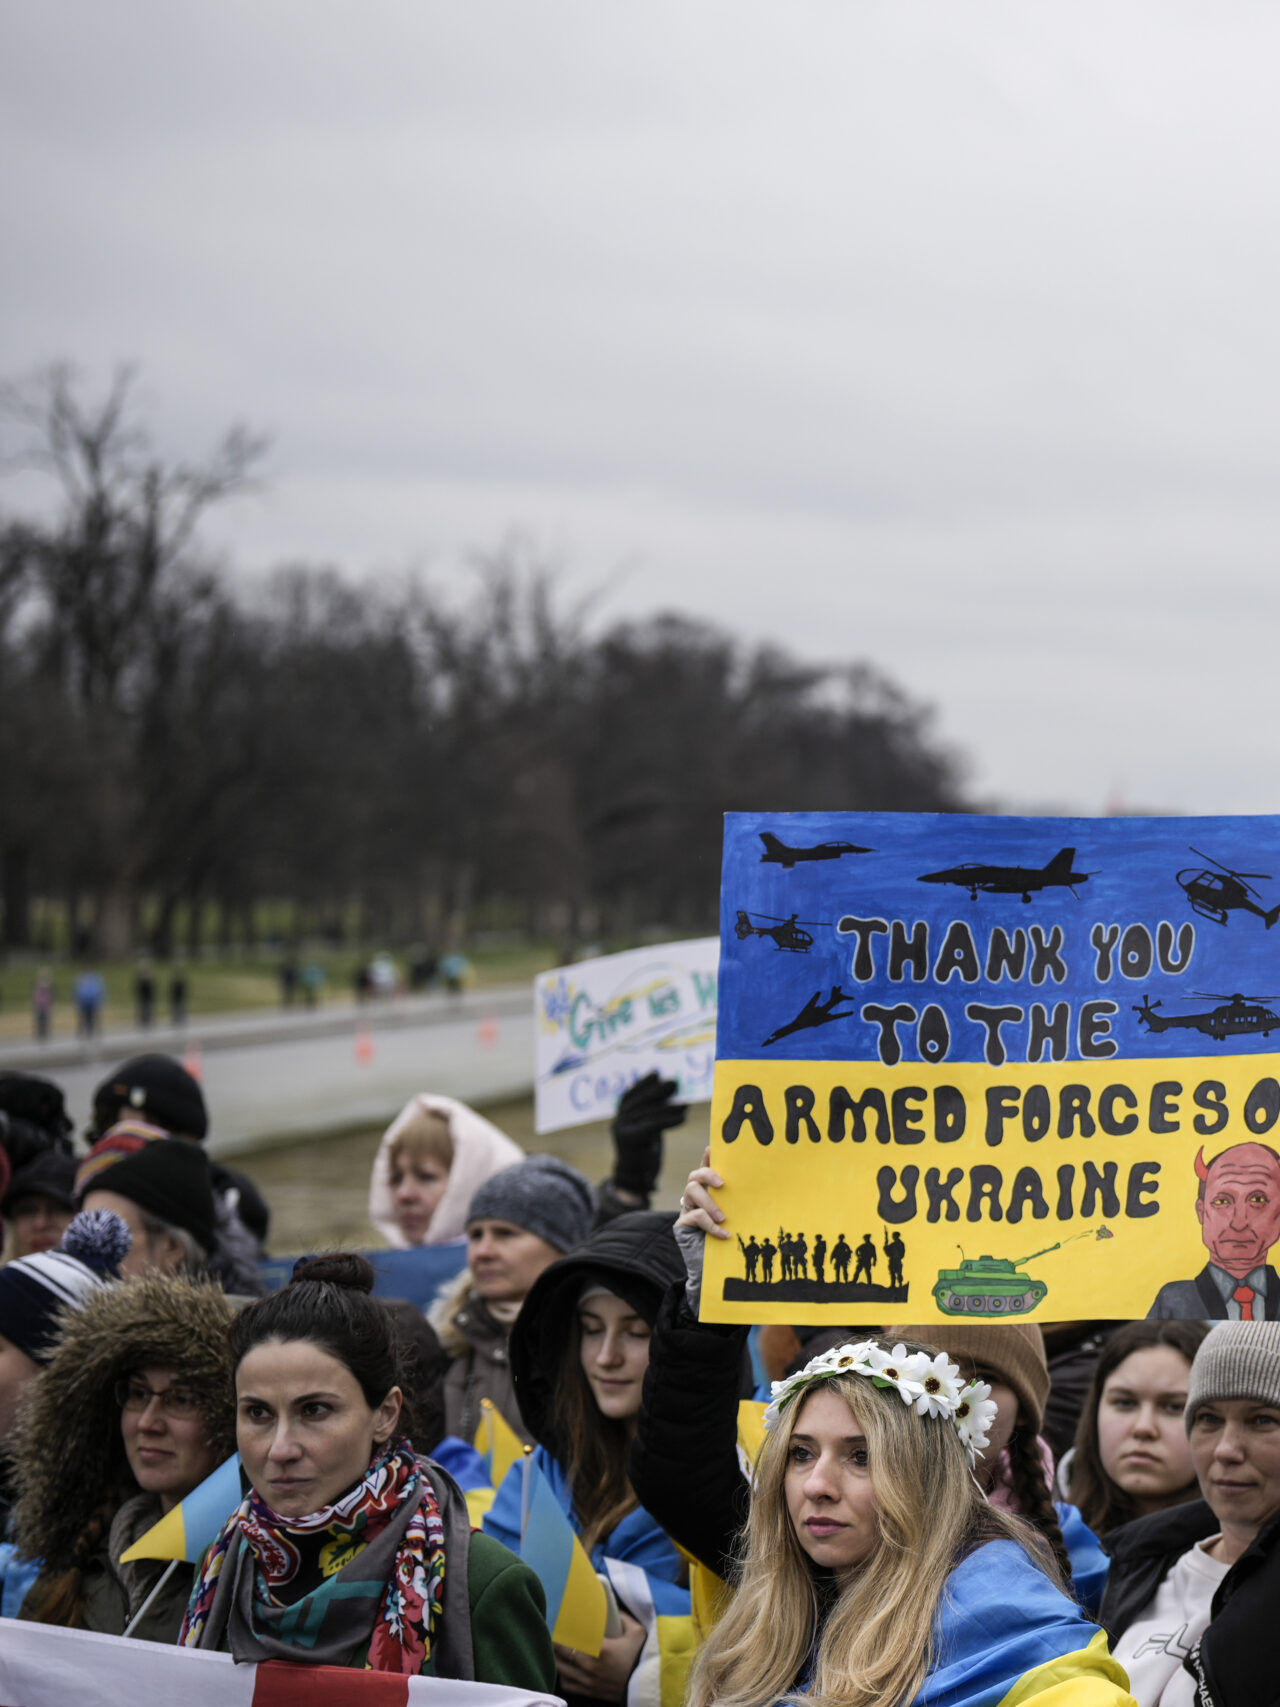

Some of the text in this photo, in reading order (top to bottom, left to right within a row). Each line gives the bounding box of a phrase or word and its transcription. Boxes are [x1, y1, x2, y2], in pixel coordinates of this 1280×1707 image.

[837, 915, 1194, 985] THANK YOU
[862, 1001, 1118, 1067] TO THE
[722, 1084, 966, 1146] ARMED
[984, 1080, 1229, 1147] FORCES
[877, 1161, 1161, 1224] UKRAINE
